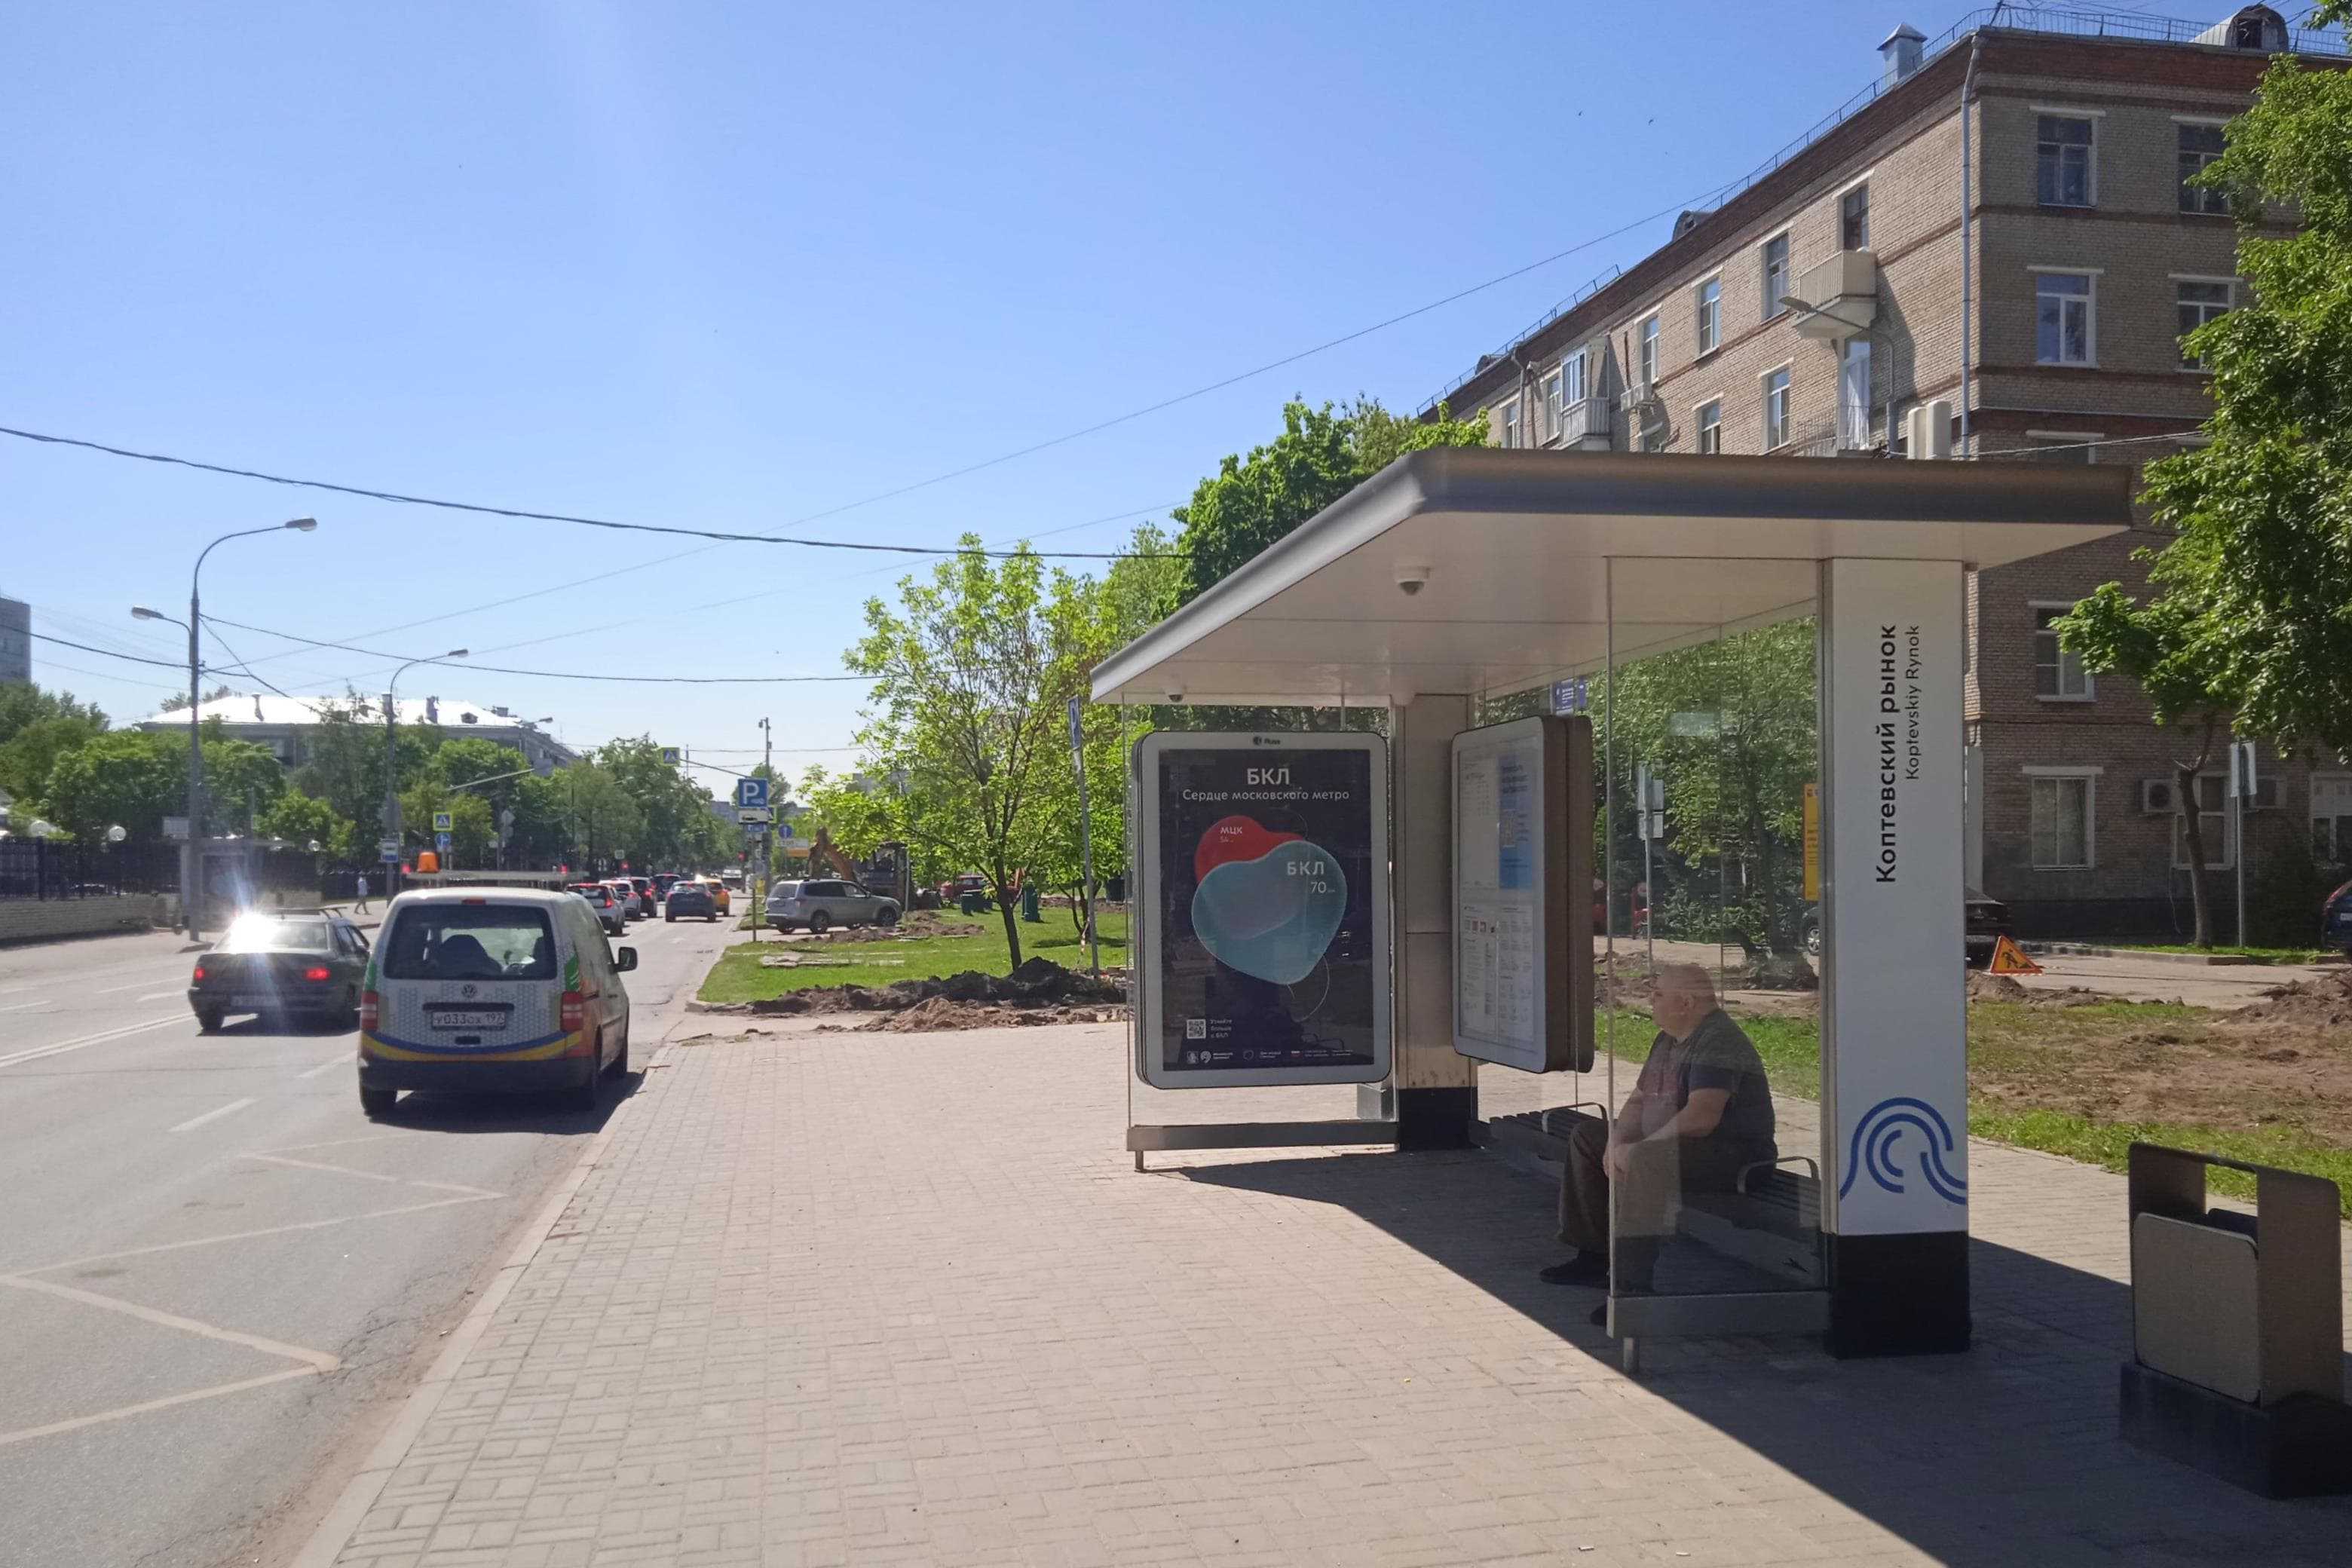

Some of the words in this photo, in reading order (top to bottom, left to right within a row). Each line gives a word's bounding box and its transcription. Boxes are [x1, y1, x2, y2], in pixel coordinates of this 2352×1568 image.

[1905, 625, 1922, 679] Rynok
[1880, 624, 1900, 714] рынок
[1905, 684, 1922, 779] Koptevskiy
[1247, 767, 1290, 785] БКЛ
[743, 782, 760, 805] P
[1182, 789, 1229, 801] Сердце
[1232, 792, 1309, 800] московского
[1312, 791, 1350, 801] метро
[1876, 723, 1897, 883] Коптевский
[1220, 826, 1243, 835] МЦК
[1287, 861, 1325, 875] БКЛ
[1310, 881, 1327, 893] 70
